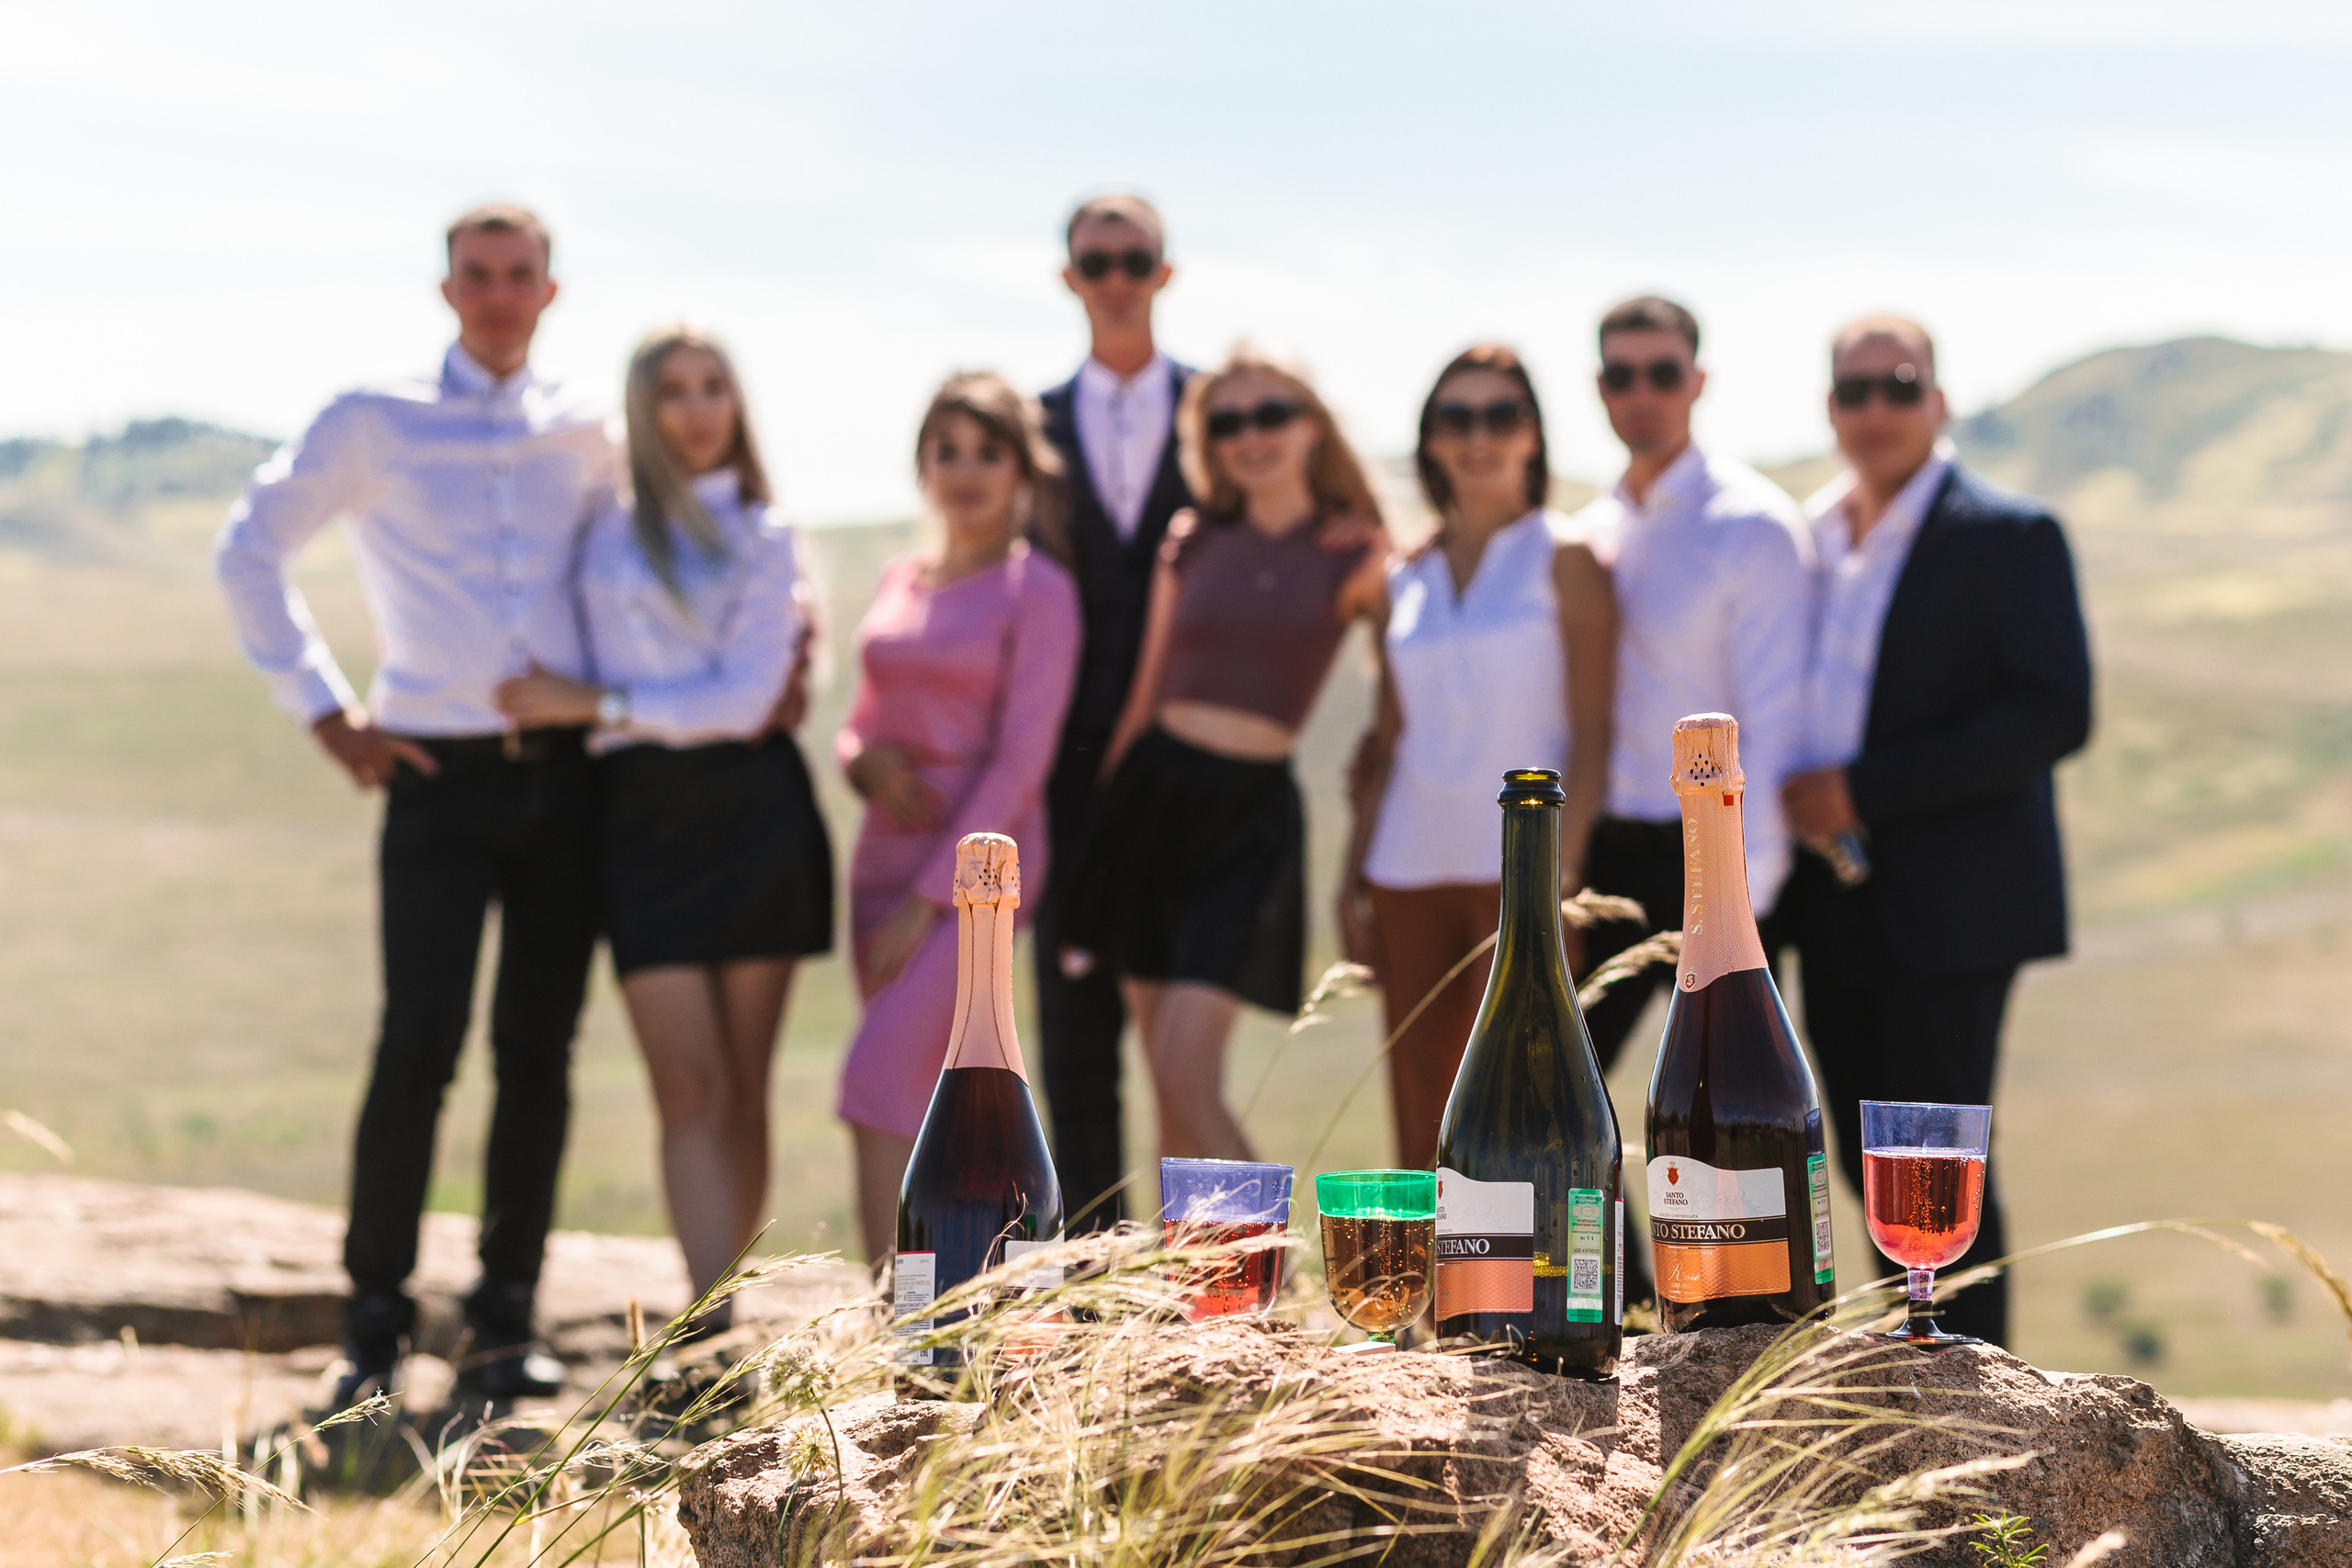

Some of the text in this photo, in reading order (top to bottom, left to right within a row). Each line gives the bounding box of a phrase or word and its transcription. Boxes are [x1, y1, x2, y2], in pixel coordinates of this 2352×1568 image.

[1687, 817, 1703, 915] STEFANO
[1663, 1198, 1689, 1206] STEFANO
[1670, 1224, 1746, 1240] STEFANO
[1436, 1238, 1490, 1256] STEFANO
[1666, 1258, 1701, 1281] Rosé
